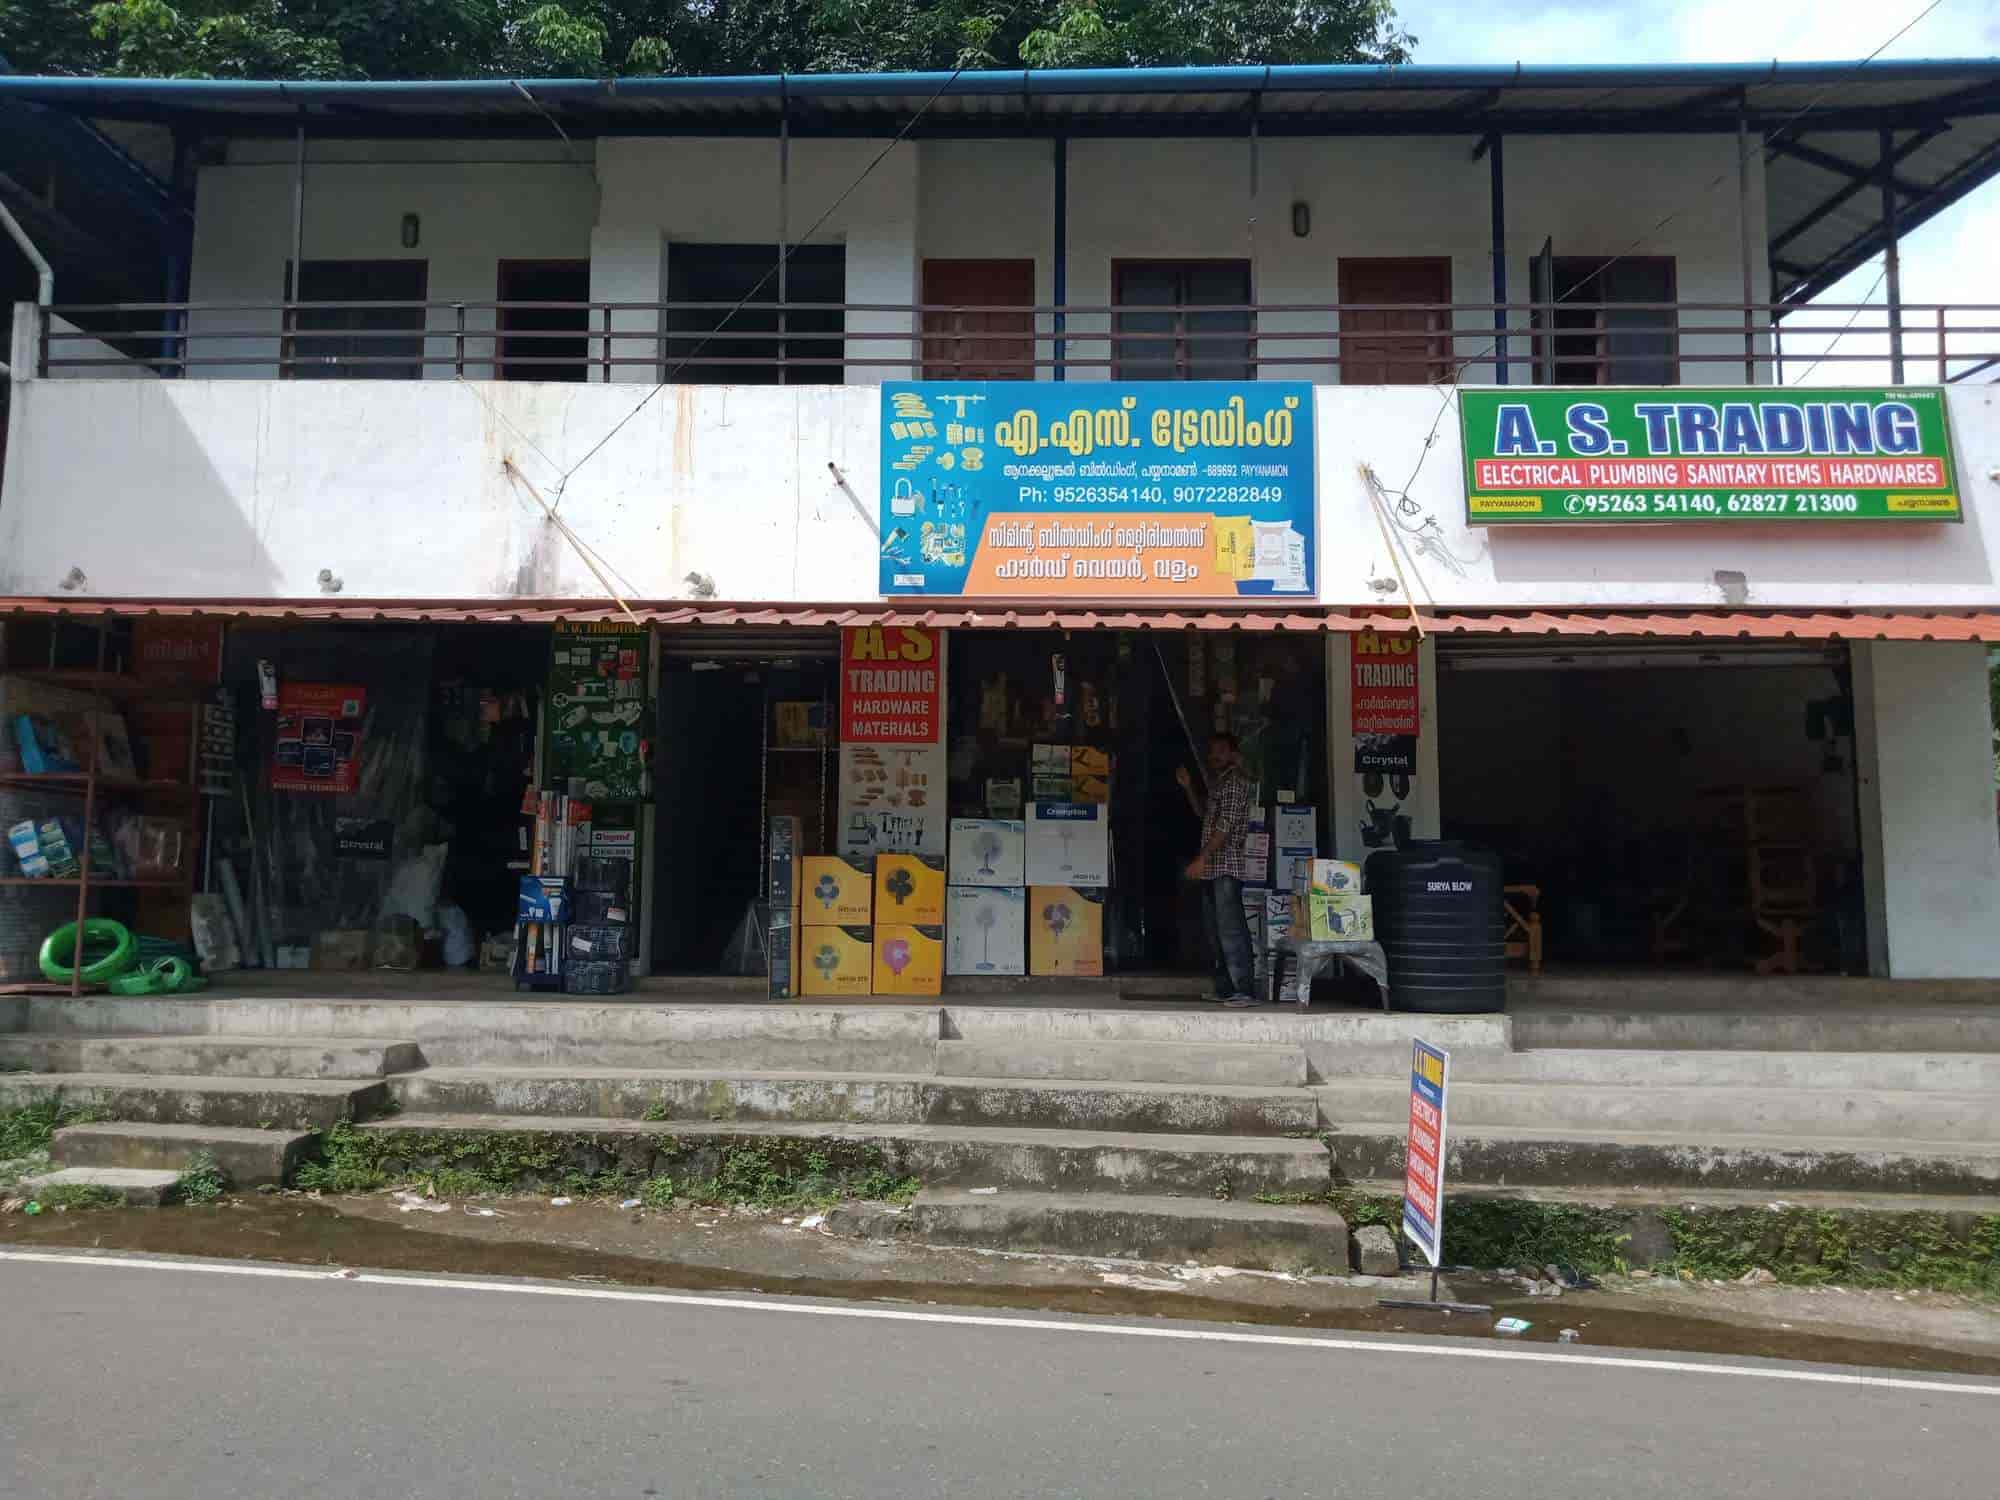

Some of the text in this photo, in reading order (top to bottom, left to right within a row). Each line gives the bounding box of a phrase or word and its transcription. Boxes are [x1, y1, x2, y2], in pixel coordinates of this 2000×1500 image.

[1493, 400, 1923, 456] A. S. TRADING
[1482, 461, 1937, 487] ELECTRICAL PLUMBING SANITARY ITEMS HARDWARES
[1019, 486, 1282, 505] Ph: 9526354140, 9072282849
[1585, 493, 1857, 514] 95263 54140, 62827 21300
[852, 627, 933, 661] A.S
[848, 669, 935, 693] TRADING
[1355, 664, 1415, 688] TRADING
[852, 700, 929, 715] HARDWARE
[852, 721, 929, 737] MATERIALS
[1427, 881, 1450, 893] SURYA
